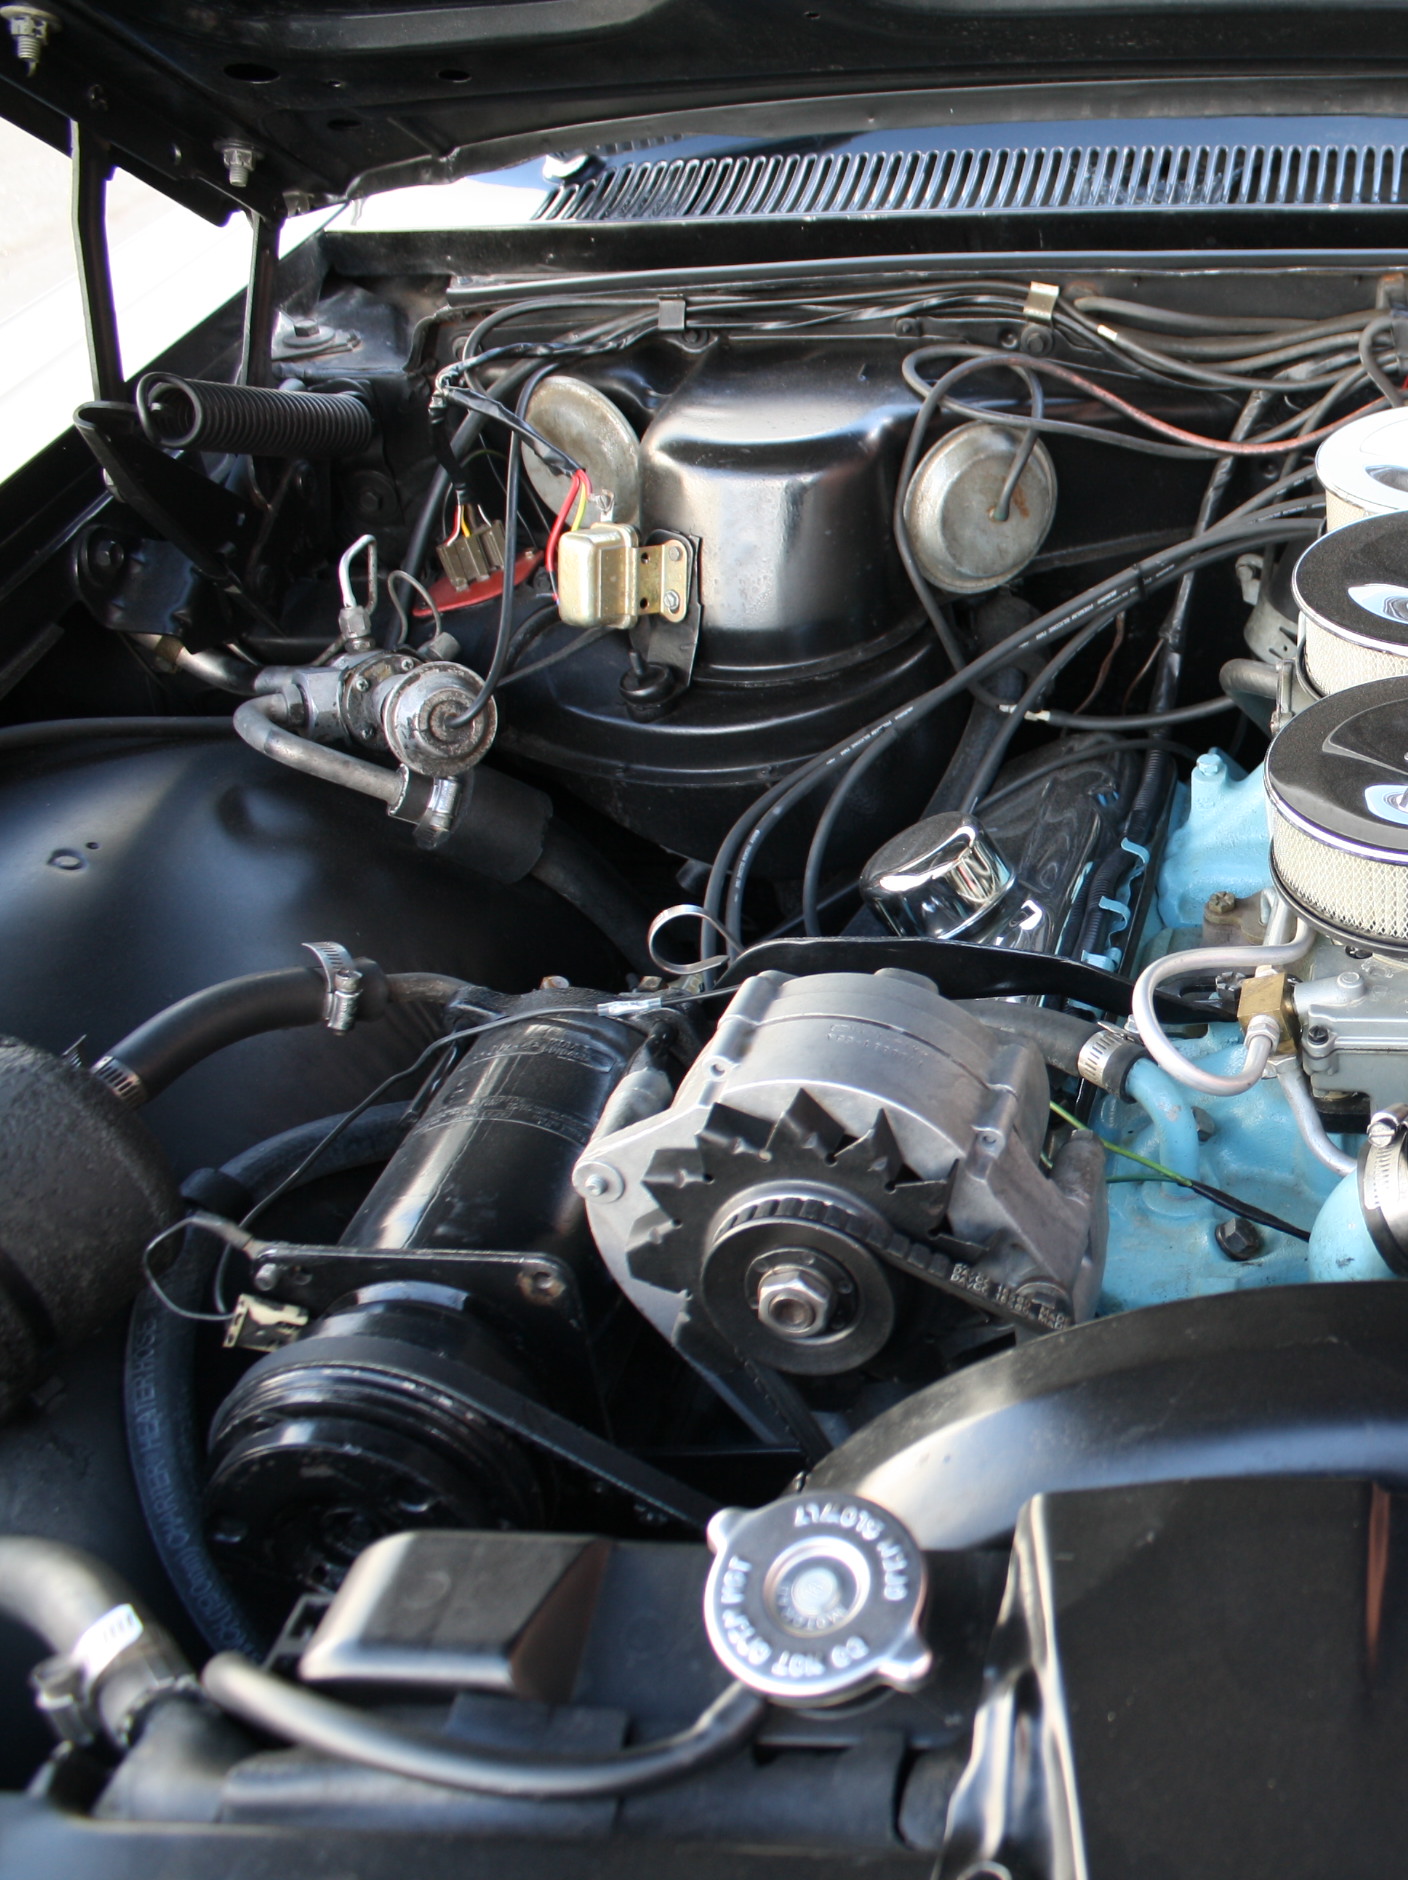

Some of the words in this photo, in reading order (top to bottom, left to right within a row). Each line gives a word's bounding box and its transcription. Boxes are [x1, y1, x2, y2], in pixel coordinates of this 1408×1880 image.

[134, 1319, 158, 1373] HOSE
[134, 1372, 163, 1450] HEATER
[793, 1502, 886, 1541] SLOWLY
[721, 1555, 752, 1604] HOT
[771, 1651, 826, 1677] NOT
[831, 1636, 870, 1669] DO
